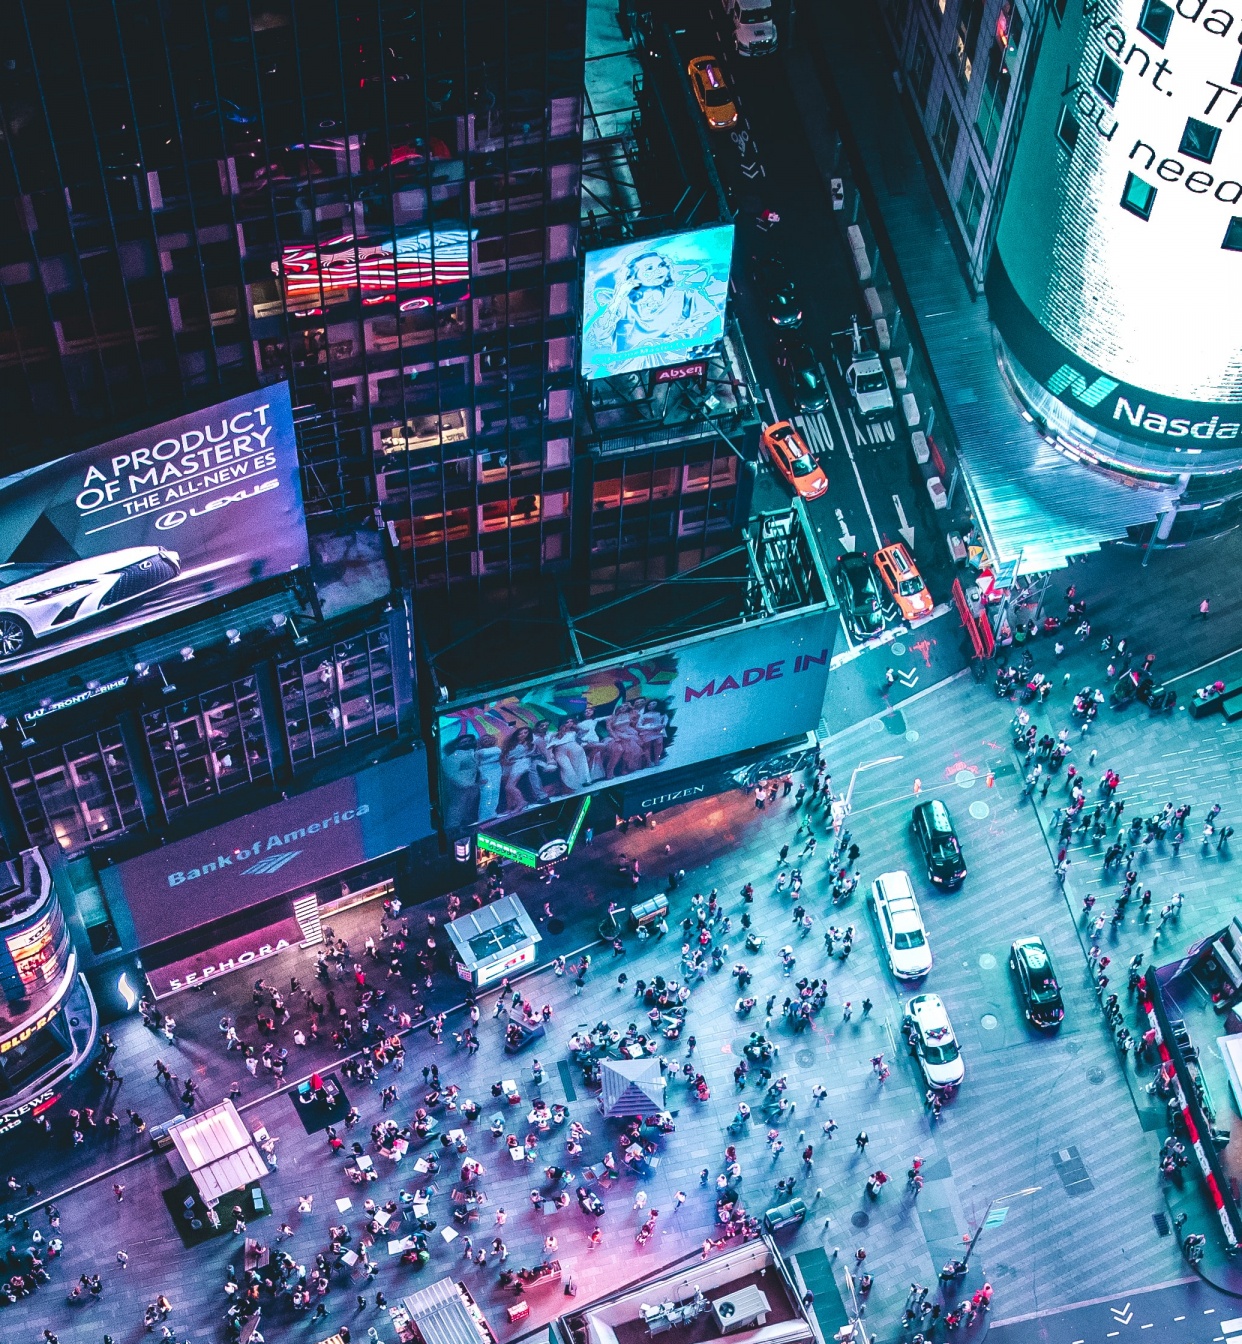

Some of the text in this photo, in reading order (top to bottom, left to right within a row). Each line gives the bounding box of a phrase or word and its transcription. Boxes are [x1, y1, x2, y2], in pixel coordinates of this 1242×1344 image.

[1083, 0, 1173, 97] want.
[1061, 63, 1119, 142] you
[659, 365, 703, 380] Absen
[84, 404, 269, 487] A PRODUCT
[1112, 396, 1242, 439] Nasda
[76, 426, 272, 510] OF MASTERY
[123, 452, 277, 515] THE ALL-NEW ES
[190, 478, 280, 517] LEXUS
[684, 649, 828, 703] MADE IN
[641, 784, 705, 808] CITIZEN
[167, 803, 370, 888] Bank of America
[170, 939, 290, 991] SEPHORA
